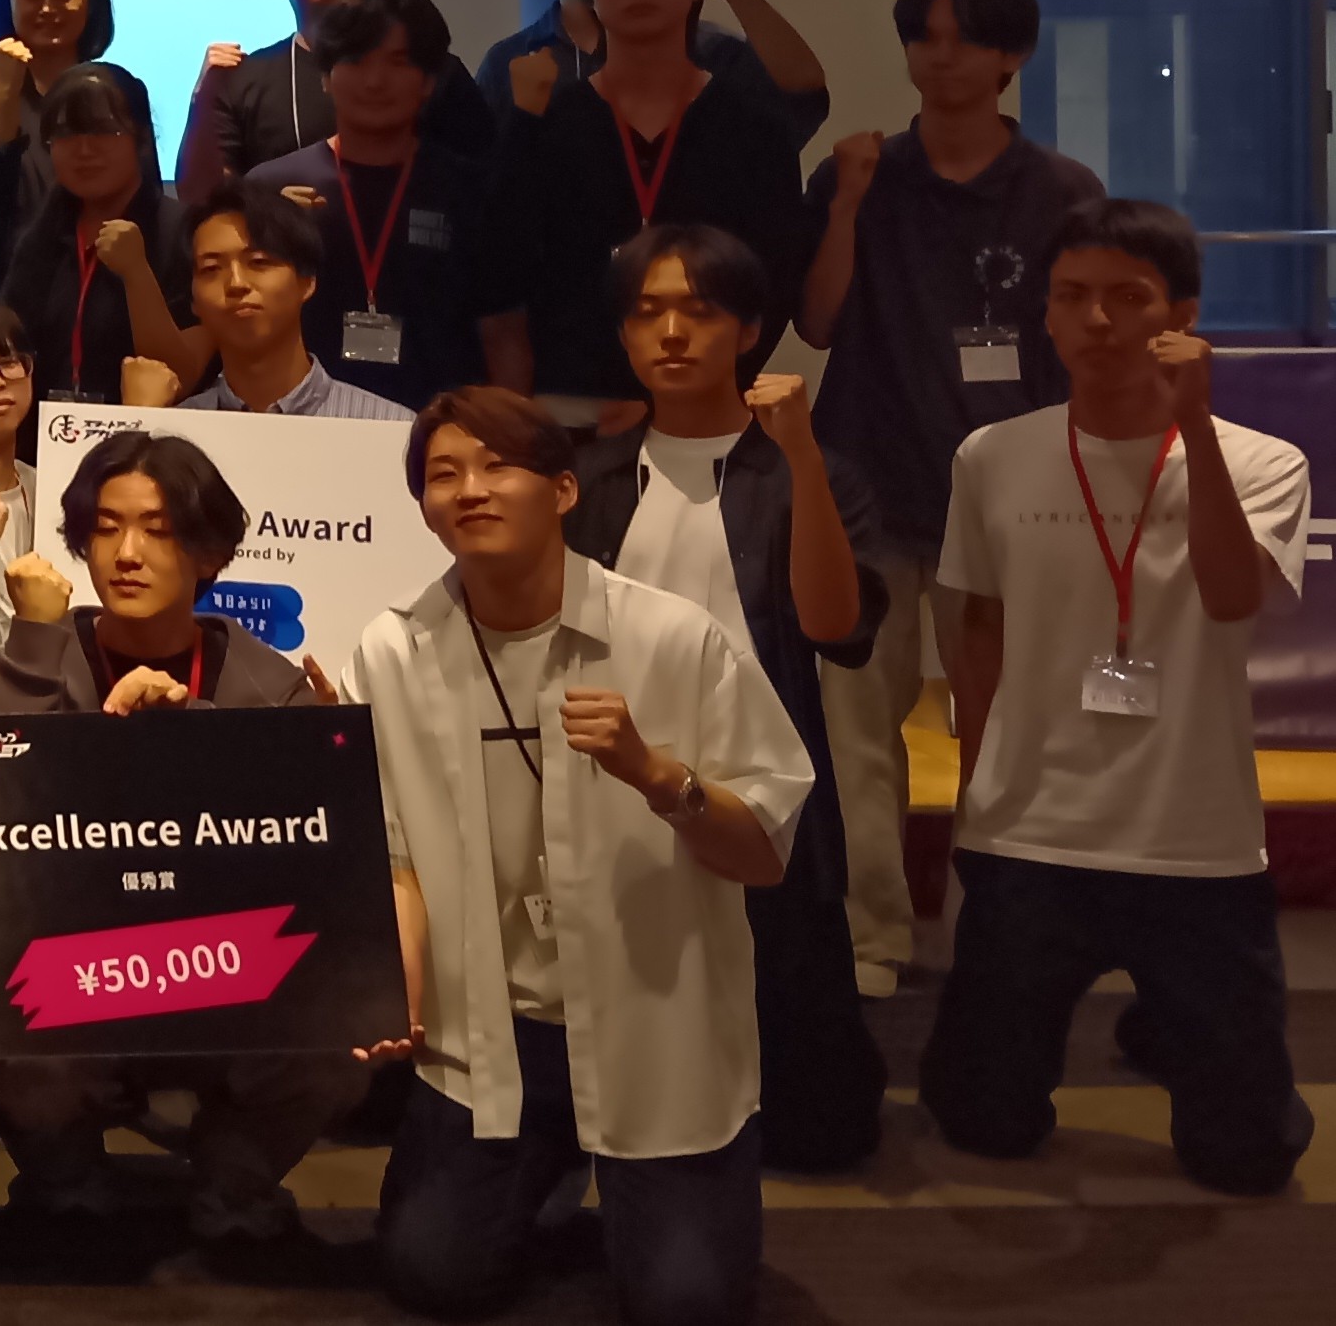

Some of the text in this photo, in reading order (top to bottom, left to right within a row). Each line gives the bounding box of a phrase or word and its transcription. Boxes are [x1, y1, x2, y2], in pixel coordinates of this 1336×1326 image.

[257, 510, 372, 543] Award
[276, 548, 295, 564] by
[194, 806, 329, 847] Award
[122, 871, 176, 891] 優秀賞
[73, 940, 241, 996] ¥50,000
